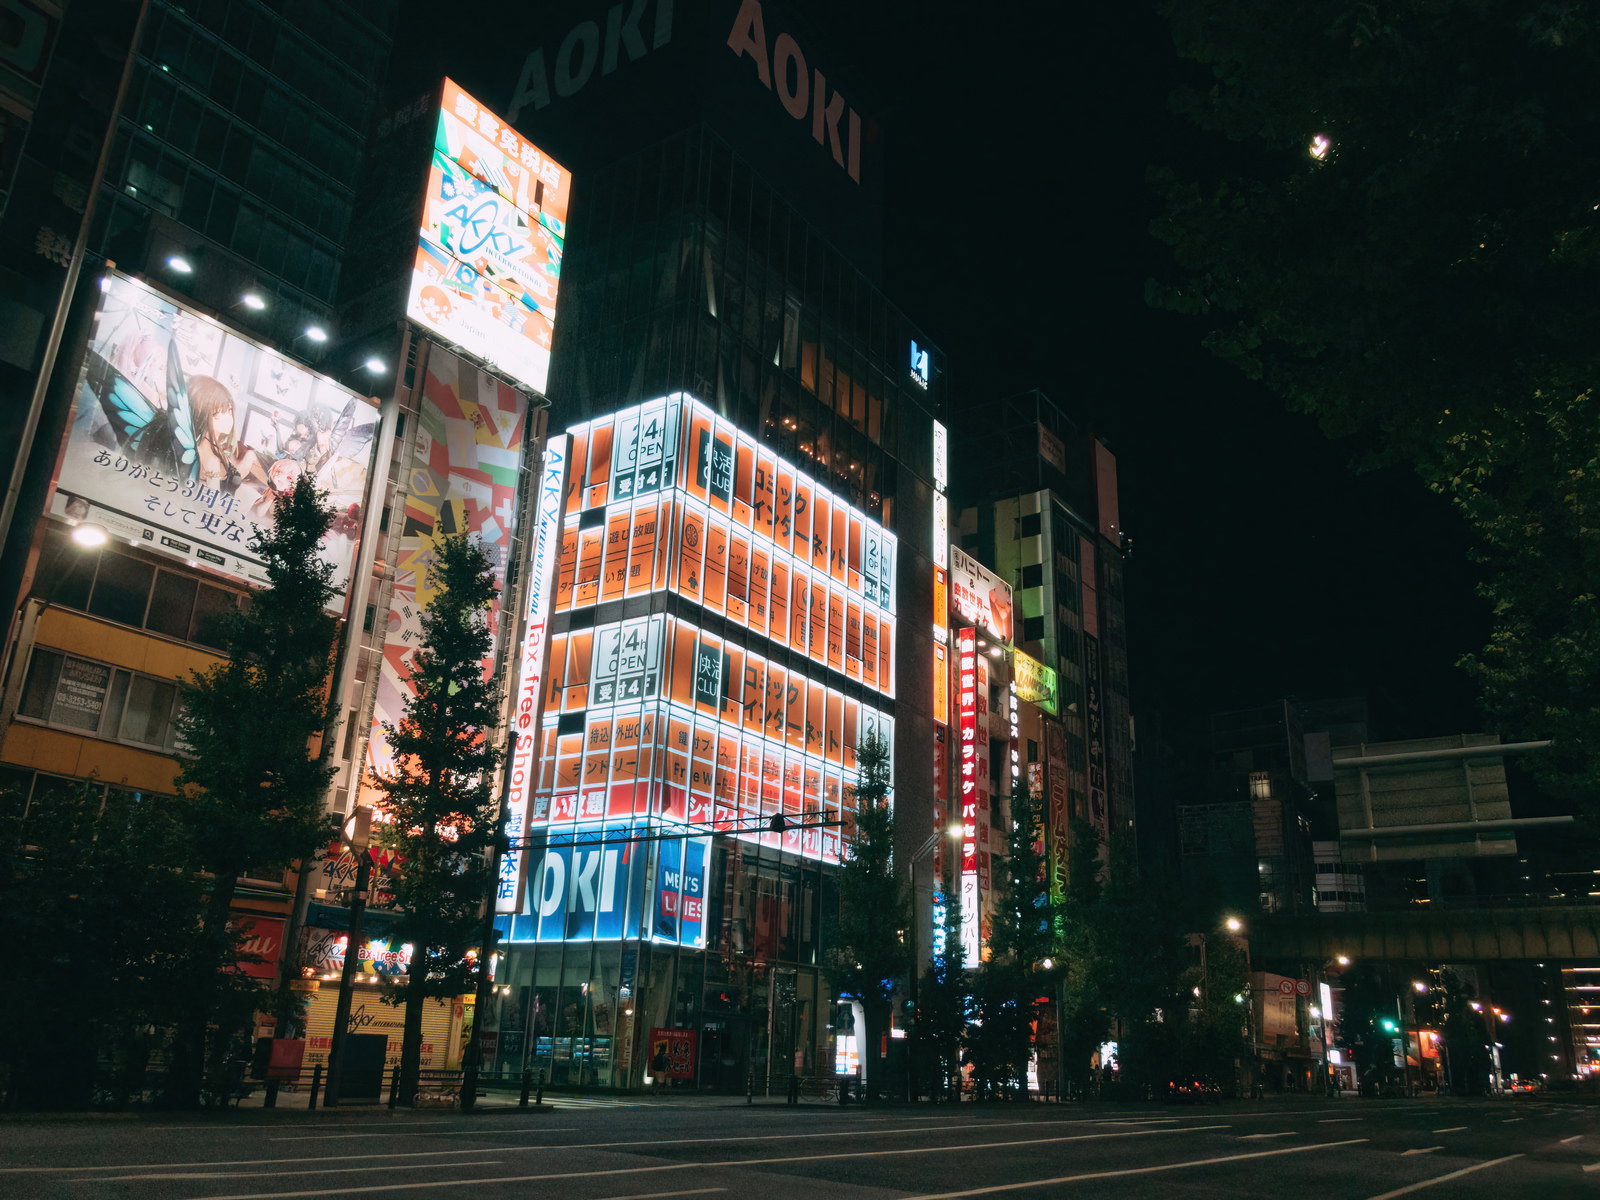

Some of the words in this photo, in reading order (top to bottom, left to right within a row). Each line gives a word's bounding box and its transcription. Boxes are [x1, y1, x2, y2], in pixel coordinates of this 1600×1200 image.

[507, 0, 674, 122] AOKI
[726, 0, 862, 185] AOKI
[444, 199, 526, 257] AKKY
[485, 245, 543, 290] INTERNATIONAL
[628, 443, 664, 462] OPEN
[93, 448, 249, 518] ありがとう3周年、
[543, 448, 563, 524] AKKY
[755, 466, 807, 517] コミック
[530, 512, 549, 615] INTERNATIONAL
[754, 499, 846, 573] インターネット
[961, 556, 990, 583] ハニトー
[514, 616, 546, 731] Tax-free
[608, 653, 647, 673] OPEN
[743, 666, 799, 706] コミック
[742, 698, 840, 753] インターネット
[509, 735, 533, 804] Shop
[962, 727, 975, 795] カラオケ
[962, 803, 976, 858] パセラ
[322, 851, 359, 891] AKK
[522, 849, 619, 917] OKI
[358, 948, 397, 963] ax-free
